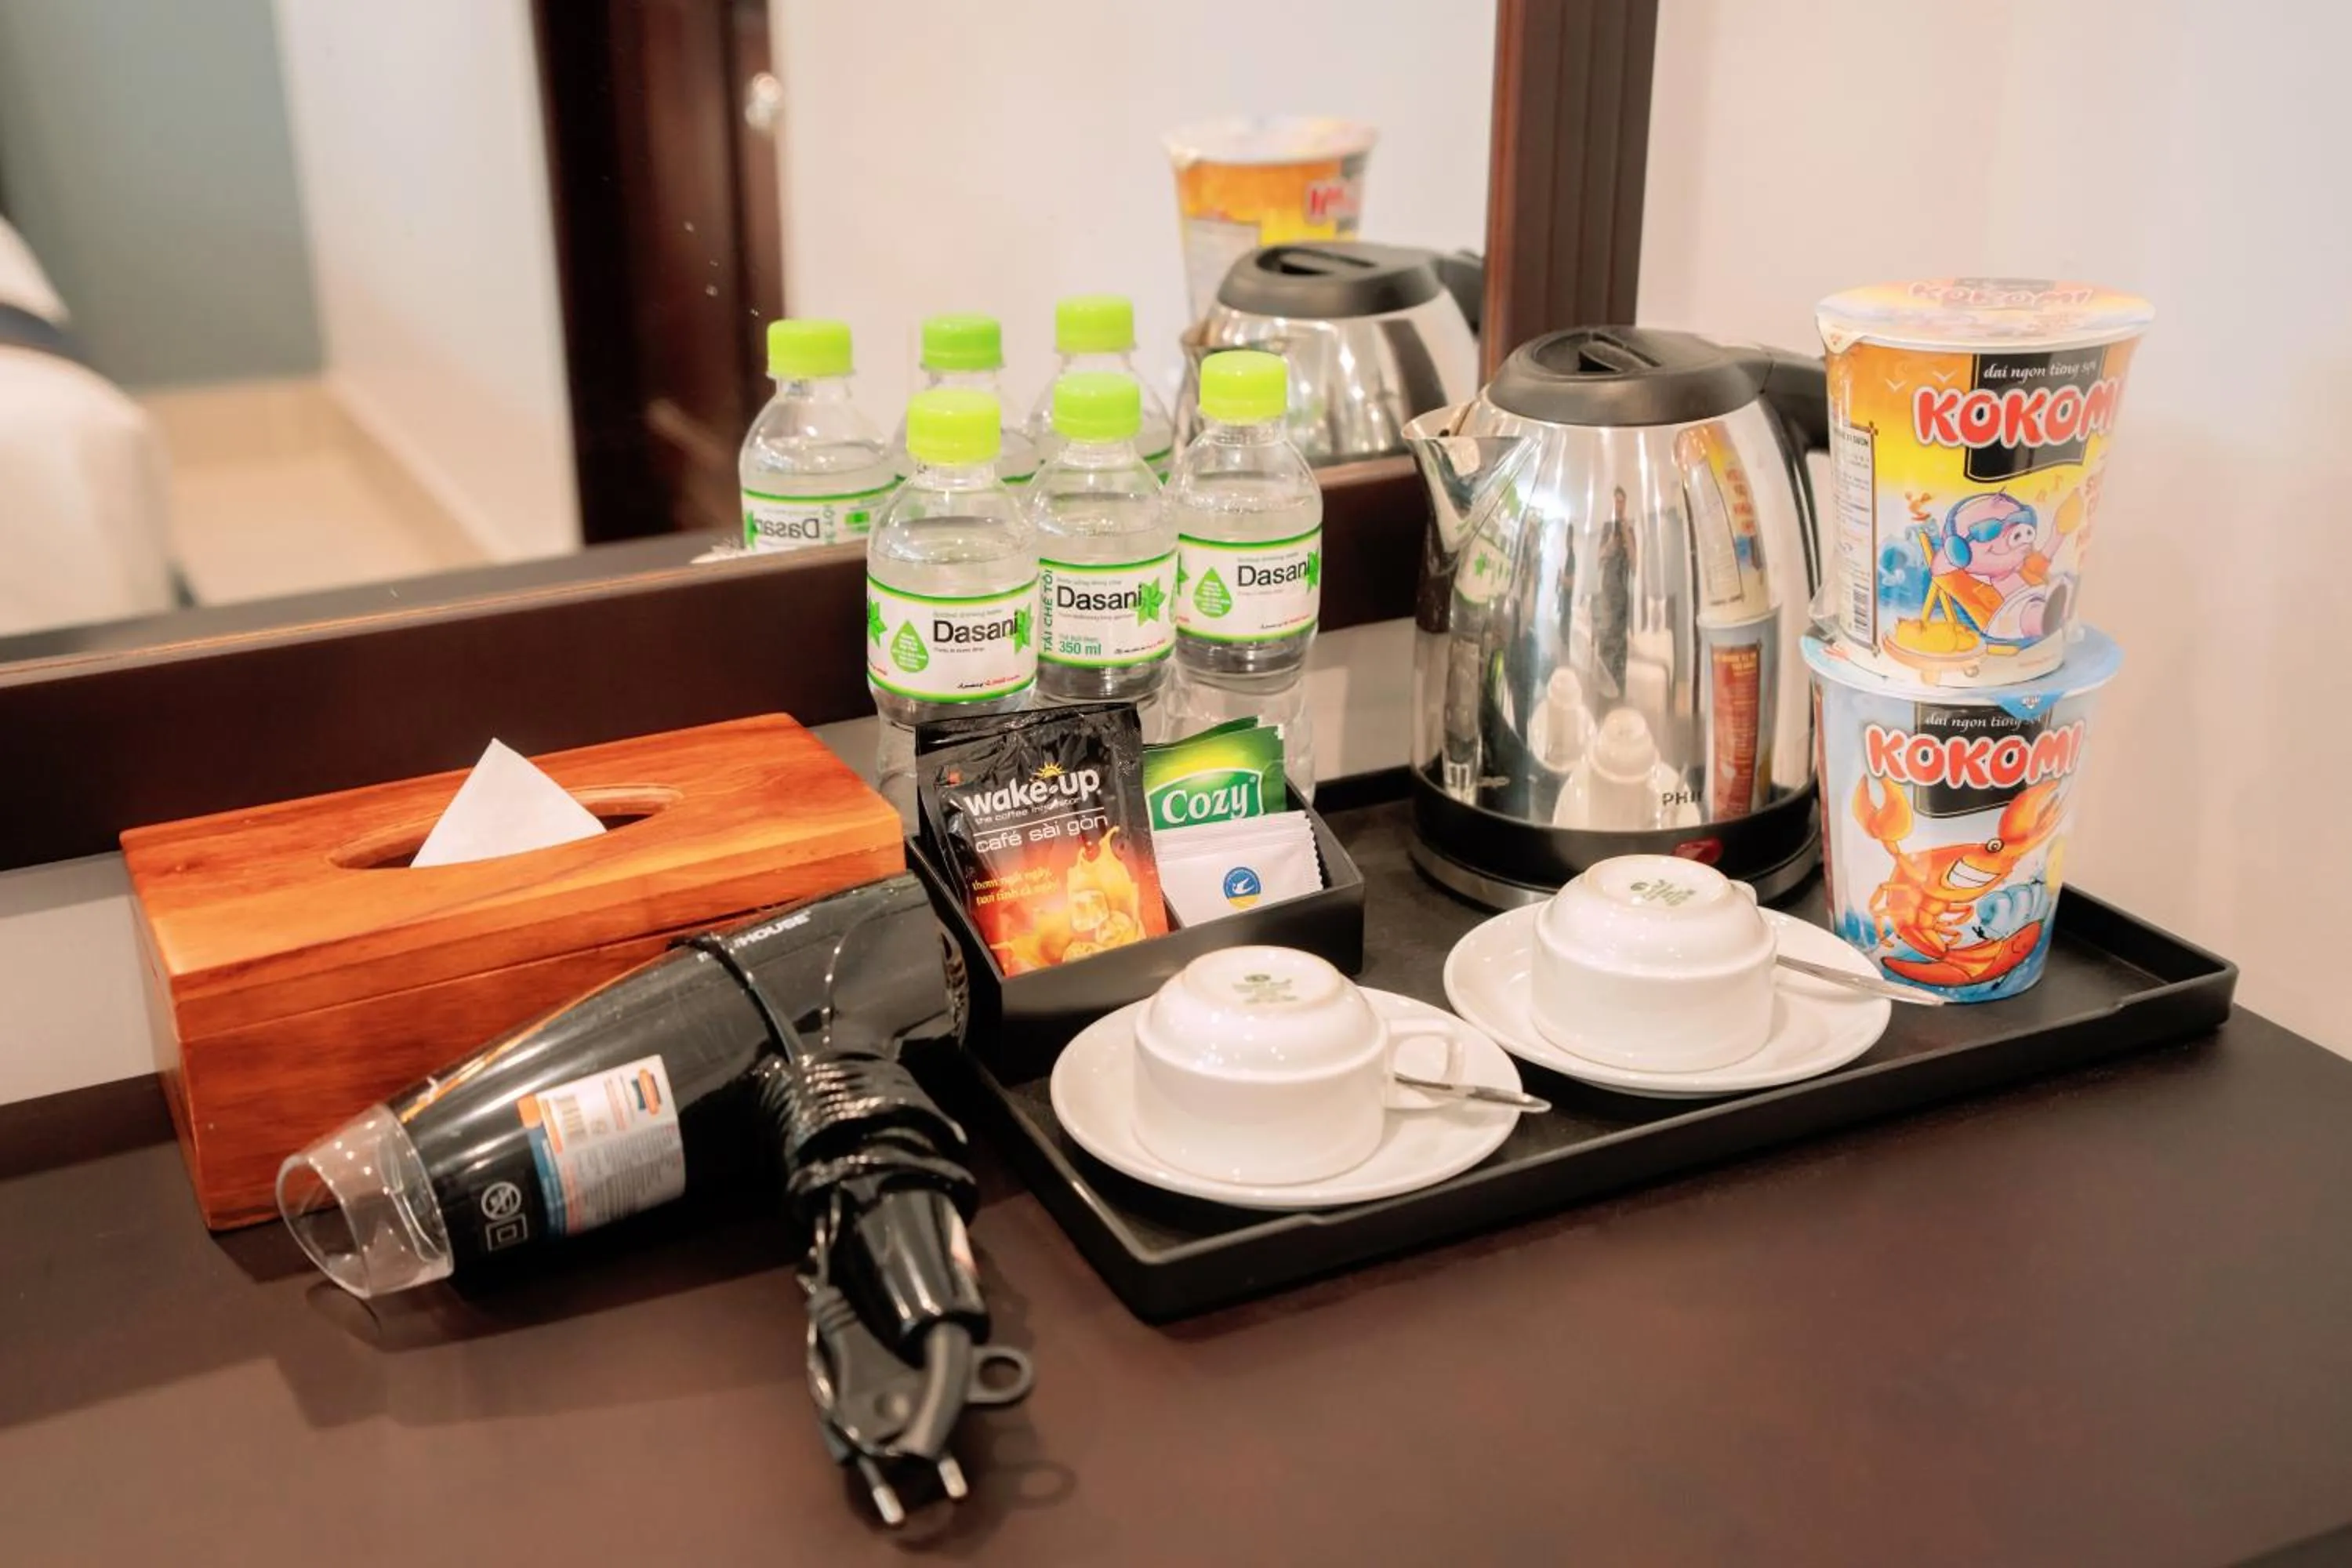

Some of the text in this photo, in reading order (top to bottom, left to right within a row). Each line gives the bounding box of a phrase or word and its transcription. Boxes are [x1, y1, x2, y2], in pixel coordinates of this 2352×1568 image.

[2010, 366, 2045, 384] ngon
[1914, 377, 2121, 449] KOKOM
[1057, 582, 1142, 611] Dasani
[933, 610, 1018, 644] Dasani
[1059, 641, 1081, 655] 350
[1085, 644, 1102, 655] ml
[1951, 716, 1987, 732] ngon
[1865, 718, 2085, 789] KOKOMI
[1162, 783, 1248, 823] Cozy
[975, 815, 1109, 853] café sài gòn
